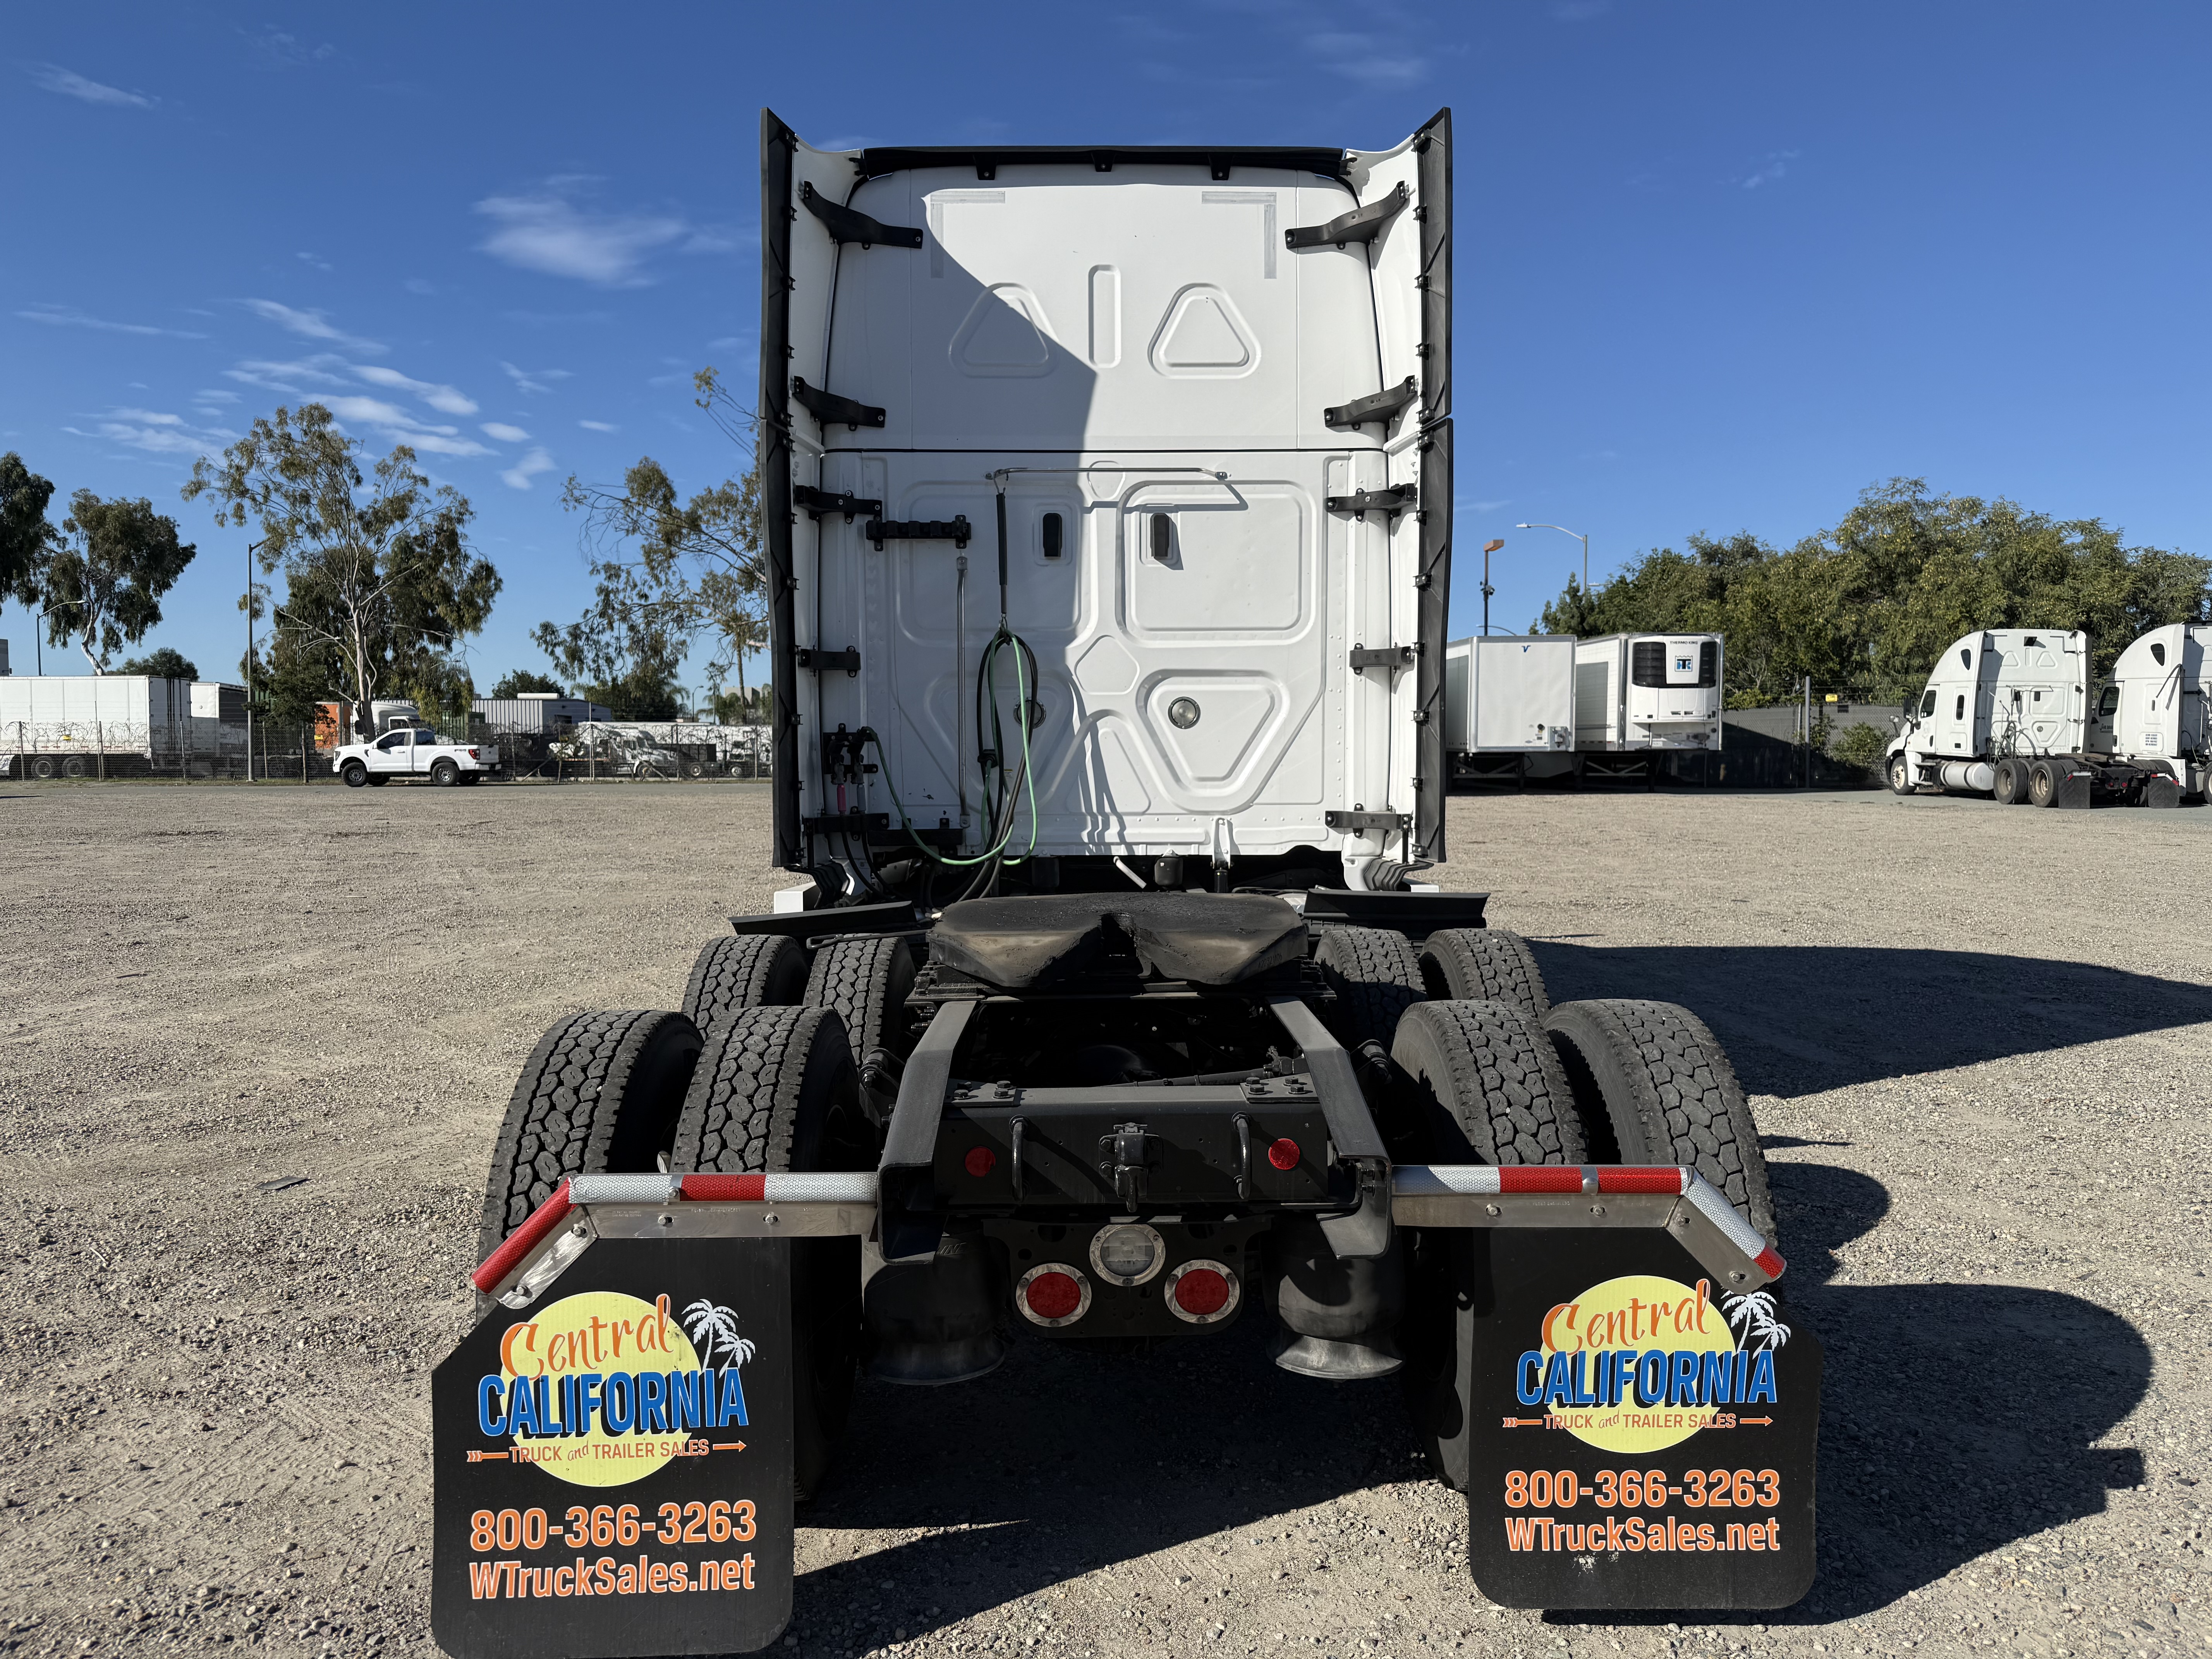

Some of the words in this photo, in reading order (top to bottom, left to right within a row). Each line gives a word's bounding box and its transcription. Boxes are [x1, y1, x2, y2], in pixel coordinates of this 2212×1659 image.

[500, 1294, 674, 1381] Central
[1542, 1278, 1711, 1356] Central
[477, 1367, 749, 1437] CALIFORNIA
[1516, 1350, 1777, 1406] CALIFORNIA
[1543, 1414, 1594, 1429] TRUCK
[1598, 1410, 1620, 1429] and
[1623, 1414, 1683, 1428] TRAILER
[1688, 1413, 1736, 1428] SALES
[510, 1445, 562, 1463] TRUCK
[567, 1441, 589, 1462] and
[592, 1443, 655, 1460] TRAILER
[660, 1439, 709, 1457] SALES
[1504, 1469, 1780, 1508] 800-366-3263
[470, 1499, 757, 1551] 800-366-3263
[1505, 1516, 1780, 1551] WTruckSales.net
[469, 1553, 756, 1599] WTruckSales.net
